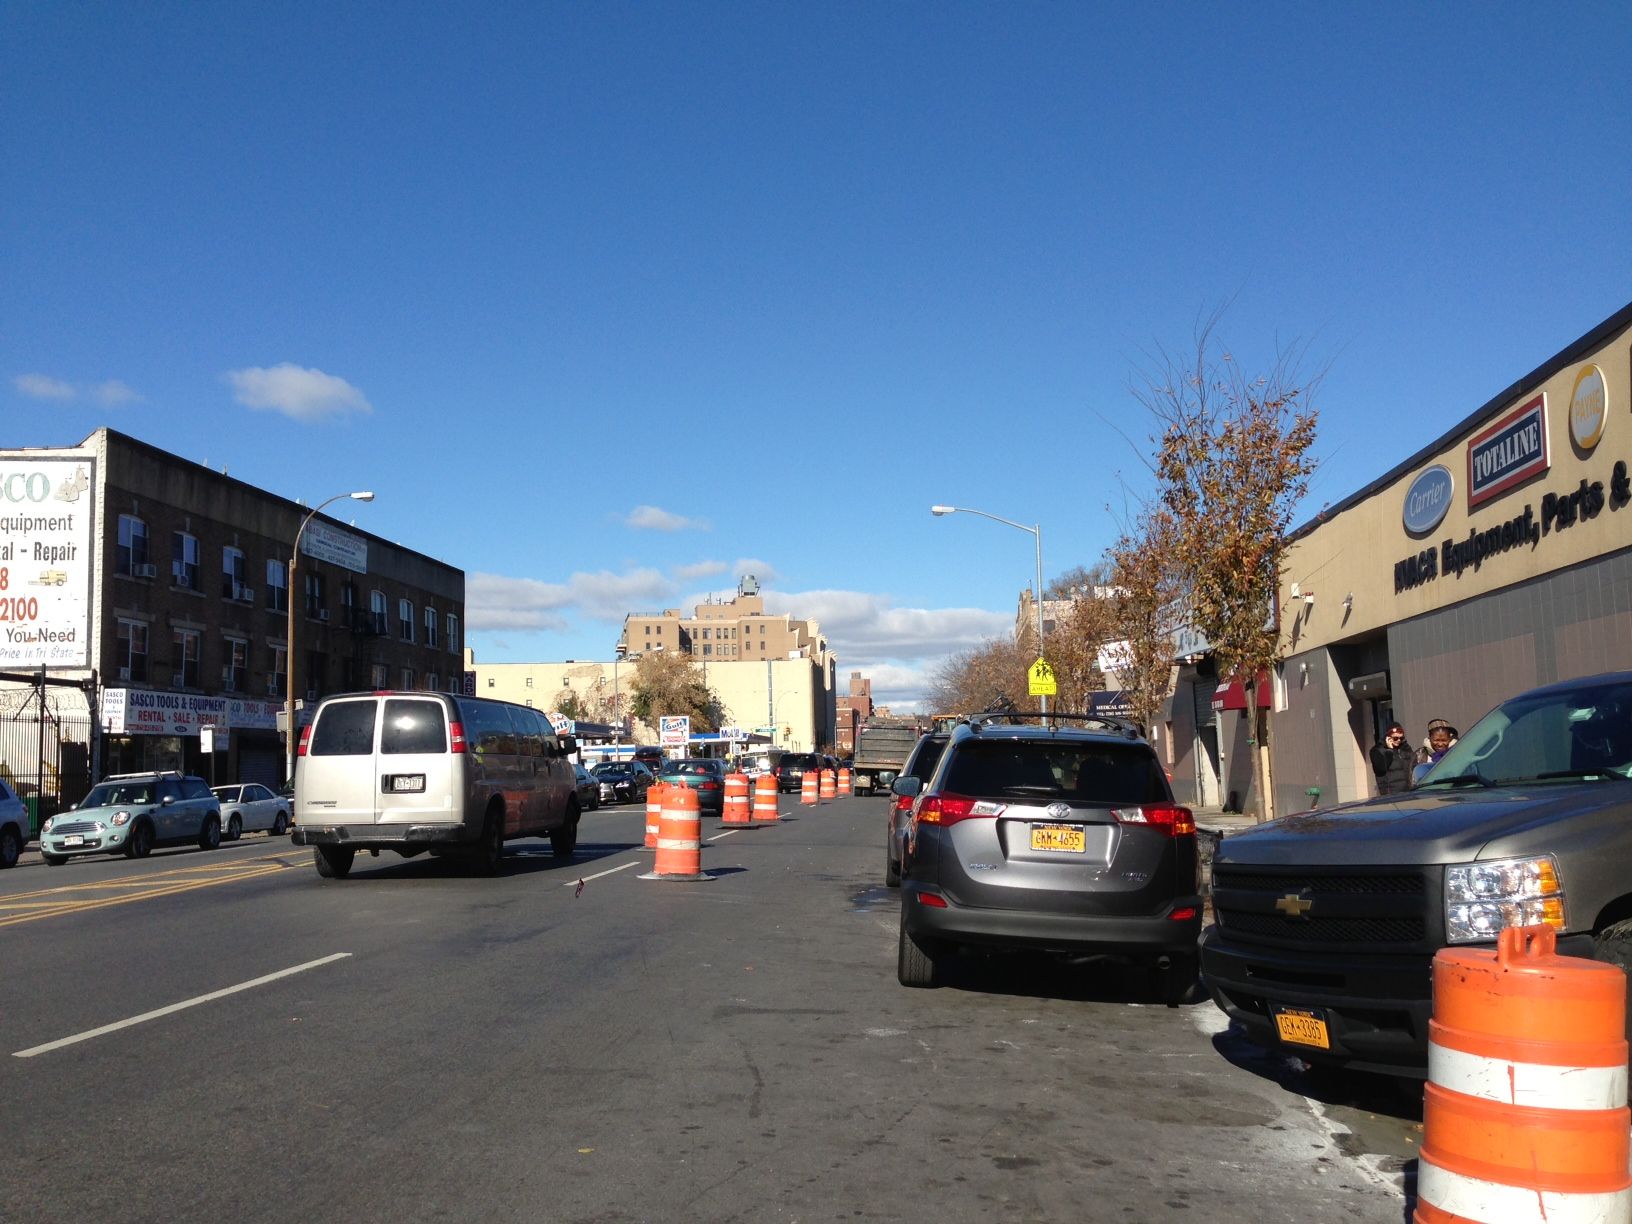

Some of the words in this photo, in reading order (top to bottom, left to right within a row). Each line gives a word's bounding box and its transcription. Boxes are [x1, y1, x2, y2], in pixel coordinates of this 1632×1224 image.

[1473, 421, 1539, 482] TOTALINE
[0, 471, 51, 503] CO
[1409, 480, 1446, 518] Carrier
[0, 512, 73, 534] quipment
[1442, 504, 1540, 575] Equipment,
[1541, 478, 1604, 533] Parts
[1612, 460, 1631, 506] &
[0, 541, 14, 561] al
[34, 541, 77, 565] Repair
[0, 566, 9, 591] 8
[0, 596, 38, 621] 2100
[6, 627, 32, 643] You
[38, 627, 76, 643] Need
[50, 647, 74, 659] State
[130, 693, 155, 708] SASCO
[156, 695, 179, 710] TOOLS
[181, 697, 188, 710] &
[189, 697, 226, 713] EQUIPMENT
[138, 710, 166, 723] RENTAL
[173, 712, 191, 724] SALE
[196, 713, 219, 725] REPAIR
[665, 719, 684, 731] Gulf
